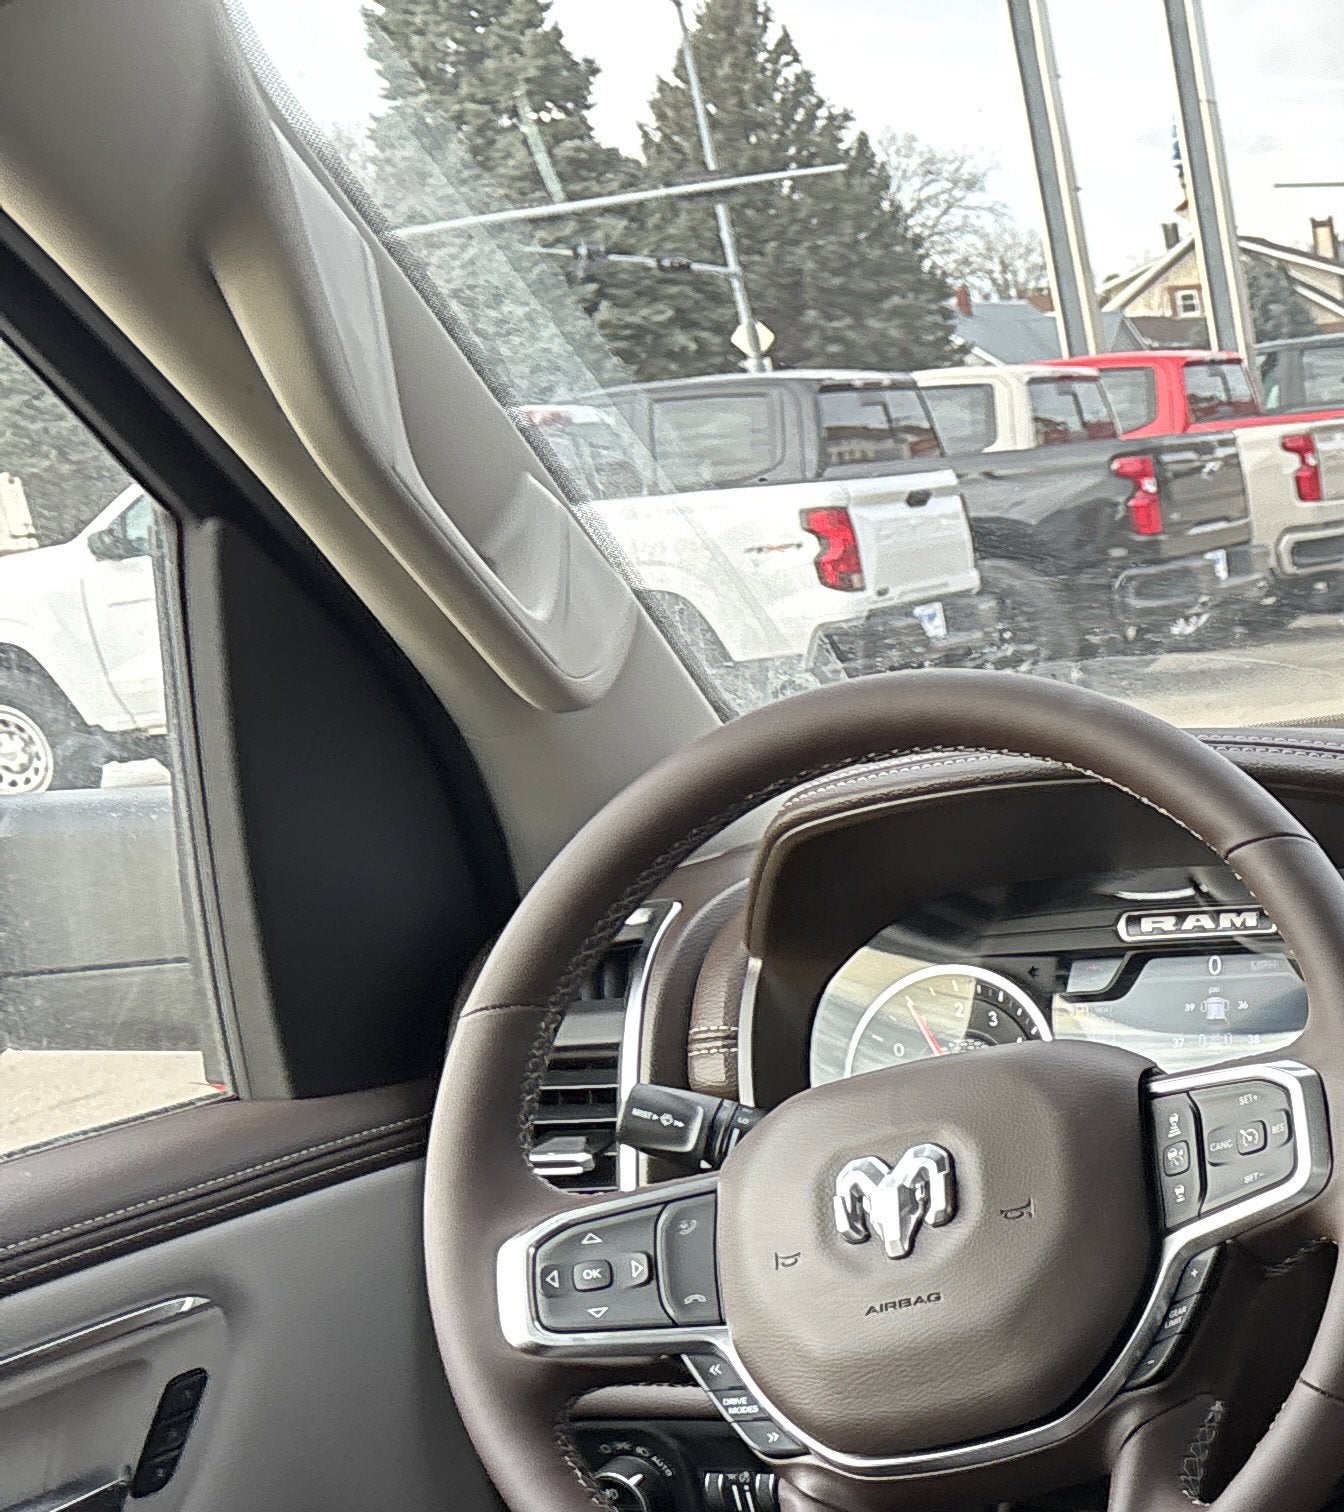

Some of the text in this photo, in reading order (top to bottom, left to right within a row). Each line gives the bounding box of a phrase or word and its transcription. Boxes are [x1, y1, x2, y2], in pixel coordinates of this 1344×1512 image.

[1140, 911, 1259, 933] RAM
[1208, 955, 1222, 975] 0
[954, 1002, 964, 1018] 2
[987, 1011, 999, 1027] 3
[893, 1043, 905, 1057] 0
[1209, 1138, 1233, 1151] CANC
[582, 1268, 602, 1280] OK
[864, 1291, 942, 1317] AIRBAG
[722, 1396, 748, 1406] DRIVE
[727, 1404, 760, 1415] MODES
